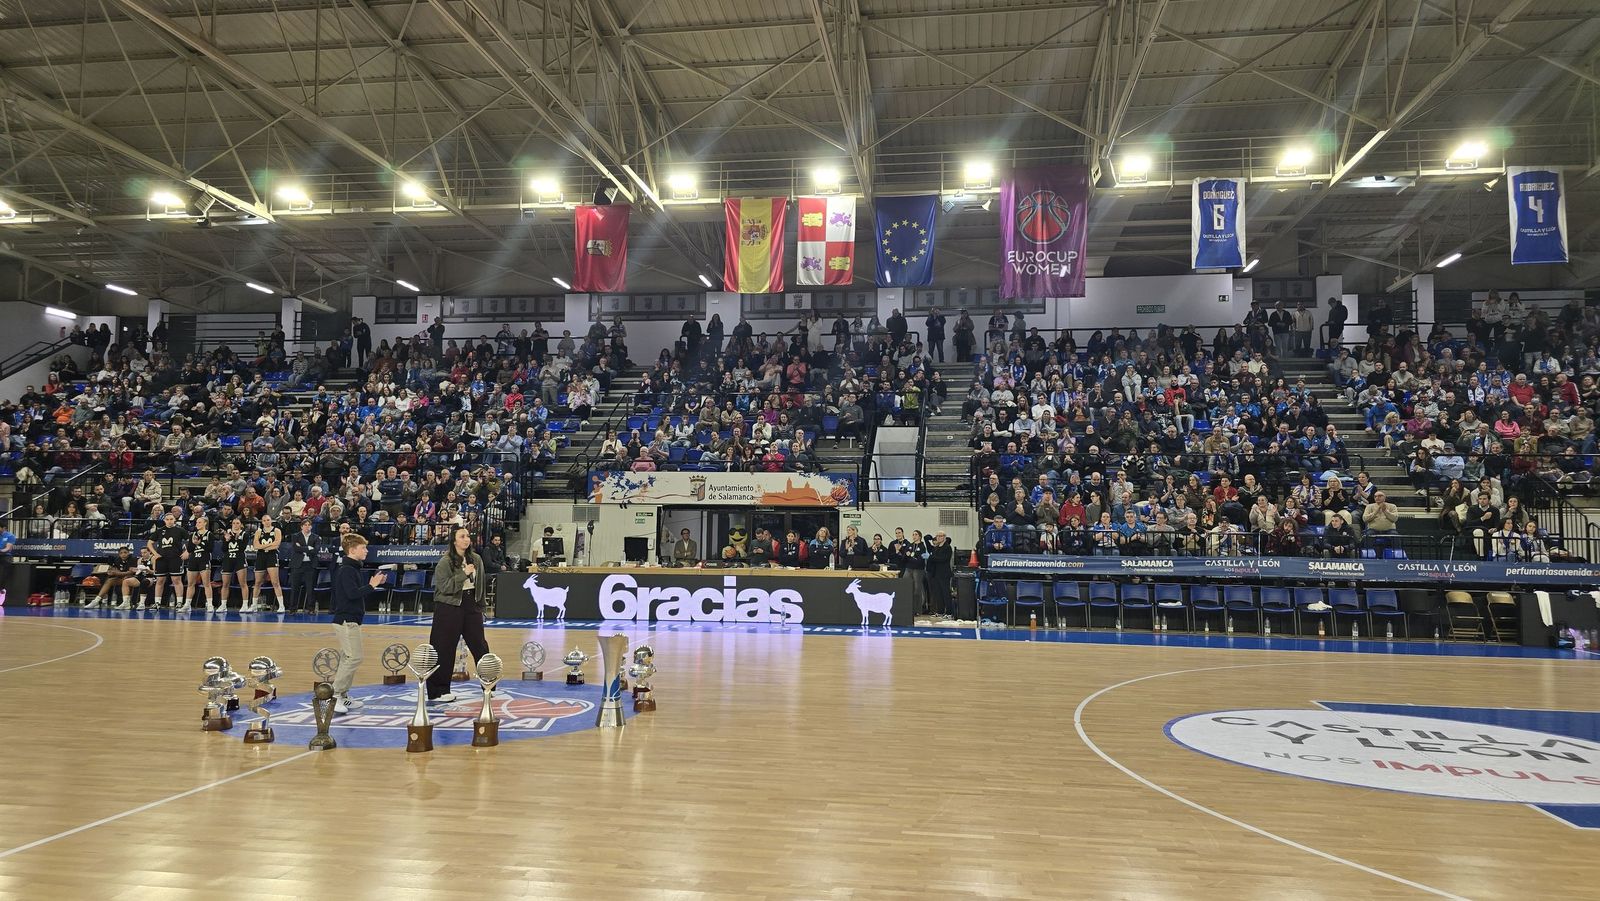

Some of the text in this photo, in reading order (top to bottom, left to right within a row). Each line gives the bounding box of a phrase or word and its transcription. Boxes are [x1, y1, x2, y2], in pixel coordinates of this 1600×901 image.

[1528, 195, 1544, 223] 4
[1213, 204, 1225, 230] 6
[1007, 251, 1078, 263] EUROCUP
[1012, 263, 1071, 275] WOMEN
[708, 484, 754, 492] Ayuntamiento
[991, 559, 1085, 568] perfumeriasavenida.com
[1248, 560, 1255, 568] Y
[1257, 558, 1280, 567] LEÓN
[1308, 561, 1364, 571] SALAMANCA
[1397, 563, 1440, 571] CASTILLA
[1443, 564, 1450, 572] Y
[1453, 562, 1477, 572] LEÓN
[598, 574, 804, 624] 6racias
[1211, 716, 1600, 750] CASTILLA
[1267, 730, 1317, 744] Y
[1263, 751, 1361, 764] NOS
